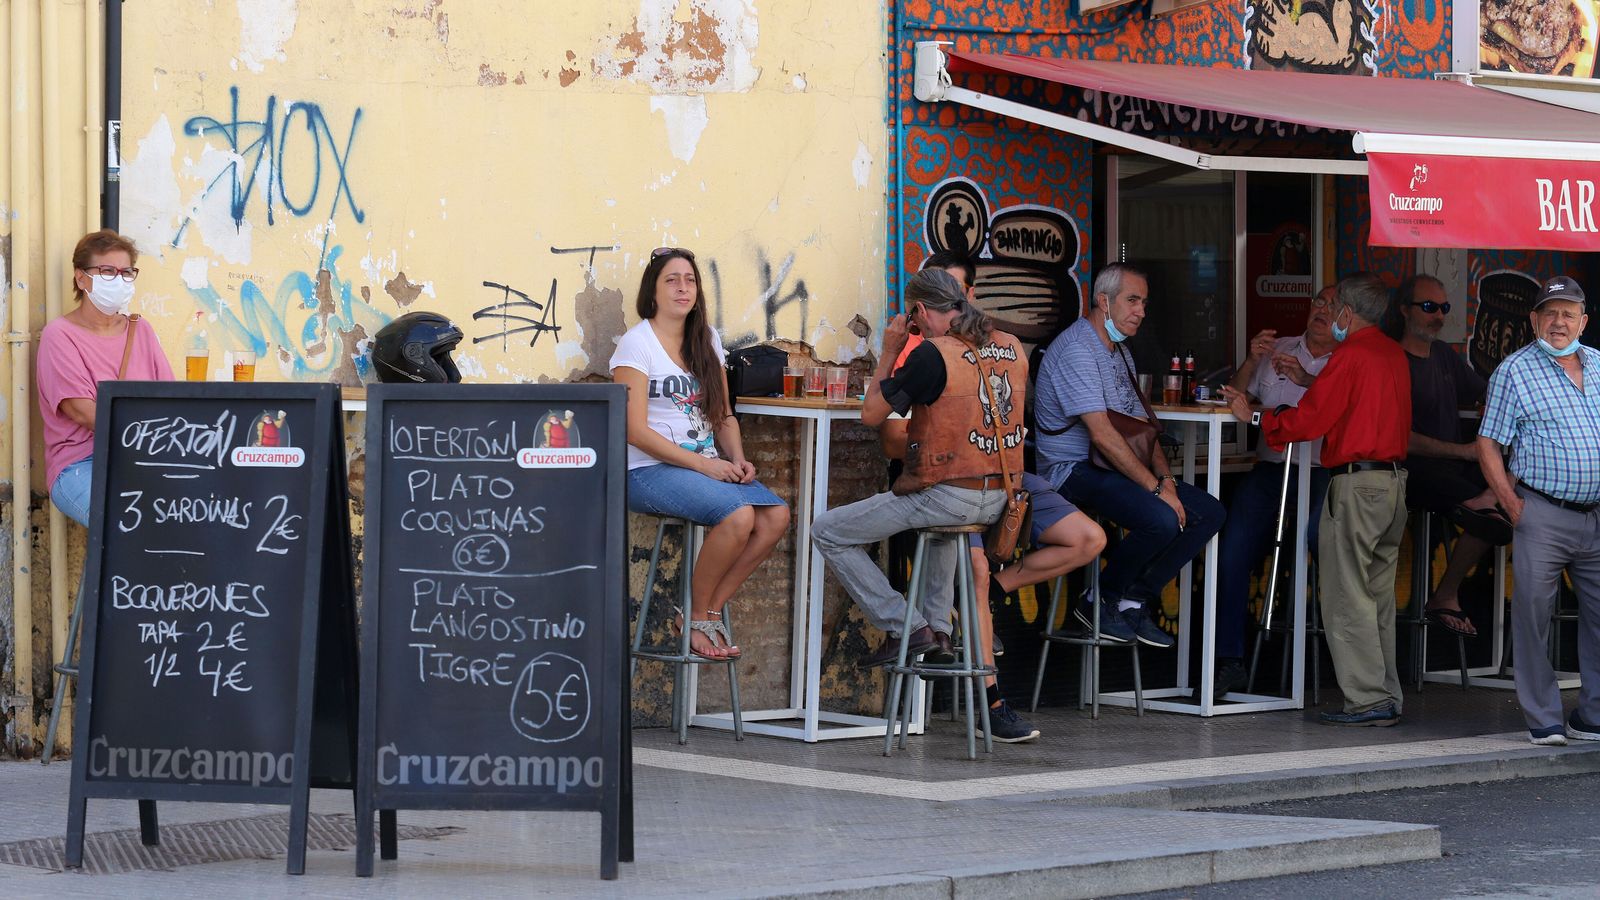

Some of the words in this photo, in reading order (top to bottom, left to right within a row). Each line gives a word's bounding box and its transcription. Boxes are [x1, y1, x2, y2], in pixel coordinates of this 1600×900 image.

[1389, 192, 1443, 214] Cruzcampo
[1536, 178, 1599, 234] BAR
[1261, 279, 1312, 296] Cruzcamp
[648, 374, 698, 398] LON
[237, 451, 300, 465] Cruzcampo
[523, 452, 591, 467] Cruzcampo
[407, 470, 515, 502] PLATO
[119, 490, 144, 533] 3
[256, 495, 302, 555] 2€
[400, 506, 547, 537] COQUINAS
[455, 539, 497, 566] 6€
[112, 575, 271, 618] BOQUERONES
[413, 578, 516, 609] PLATO
[138, 620, 184, 644] TAPA
[196, 621, 249, 652] 2€
[410, 609, 586, 642] LANGOSTINO
[144, 647, 181, 687] 1/2
[199, 656, 253, 697] 4€
[408, 643, 516, 687] TIGRE
[520, 661, 581, 729] 5€
[89, 734, 295, 787] Cruzcampo
[377, 742, 604, 793] Cruzcampo
